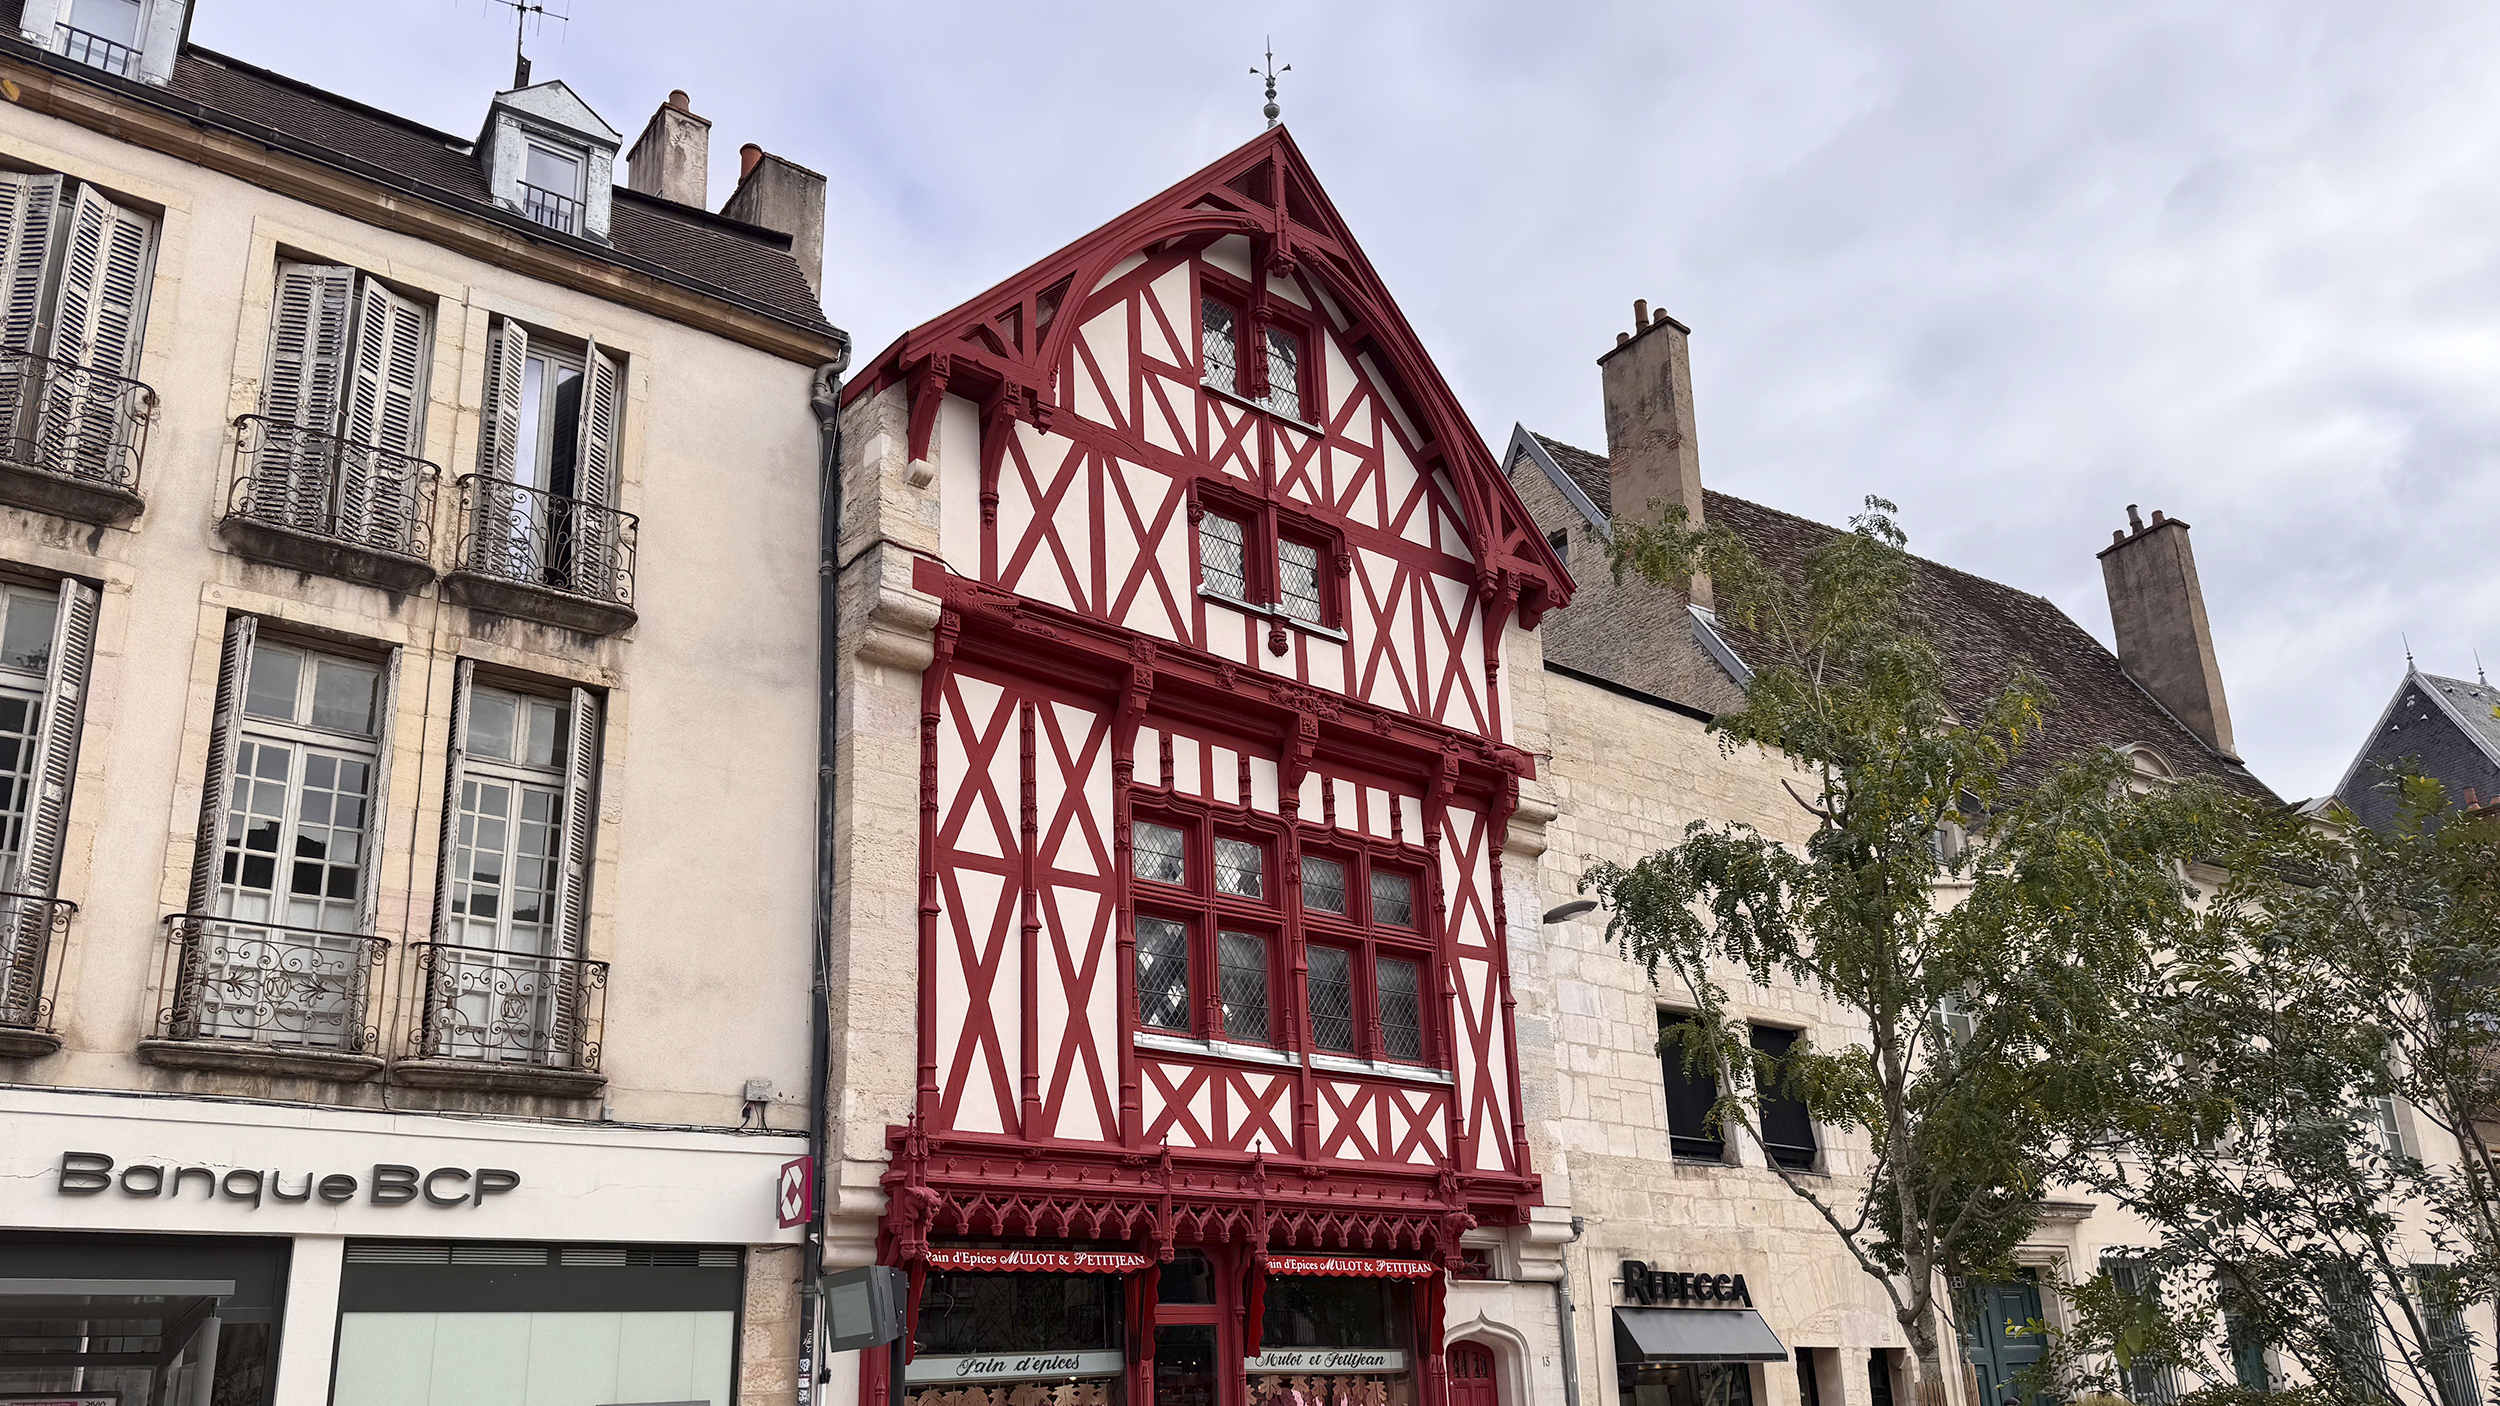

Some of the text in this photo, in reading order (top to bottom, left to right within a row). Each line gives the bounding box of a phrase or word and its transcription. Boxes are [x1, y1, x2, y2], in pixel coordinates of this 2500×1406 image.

[58, 1151, 520, 1209] Banque BCP
[952, 1251, 997, 1266] d'Epices
[1000, 1251, 1055, 1265] MULOT
[1058, 1254, 1070, 1266] &
[1073, 1252, 1146, 1268] PETITJEAN
[1268, 1258, 1282, 1269] ain
[1320, 1258, 1362, 1272] MULOT
[1364, 1261, 1373, 1272] &
[1376, 1260, 1432, 1275] PETITJEAN
[1623, 1260, 1753, 1308] REBECCA
[956, 1354, 1080, 1377] Pain d'epices
[1255, 1351, 1386, 1369] Mulot et Petitjean
[1542, 1356, 1550, 1367] 13
